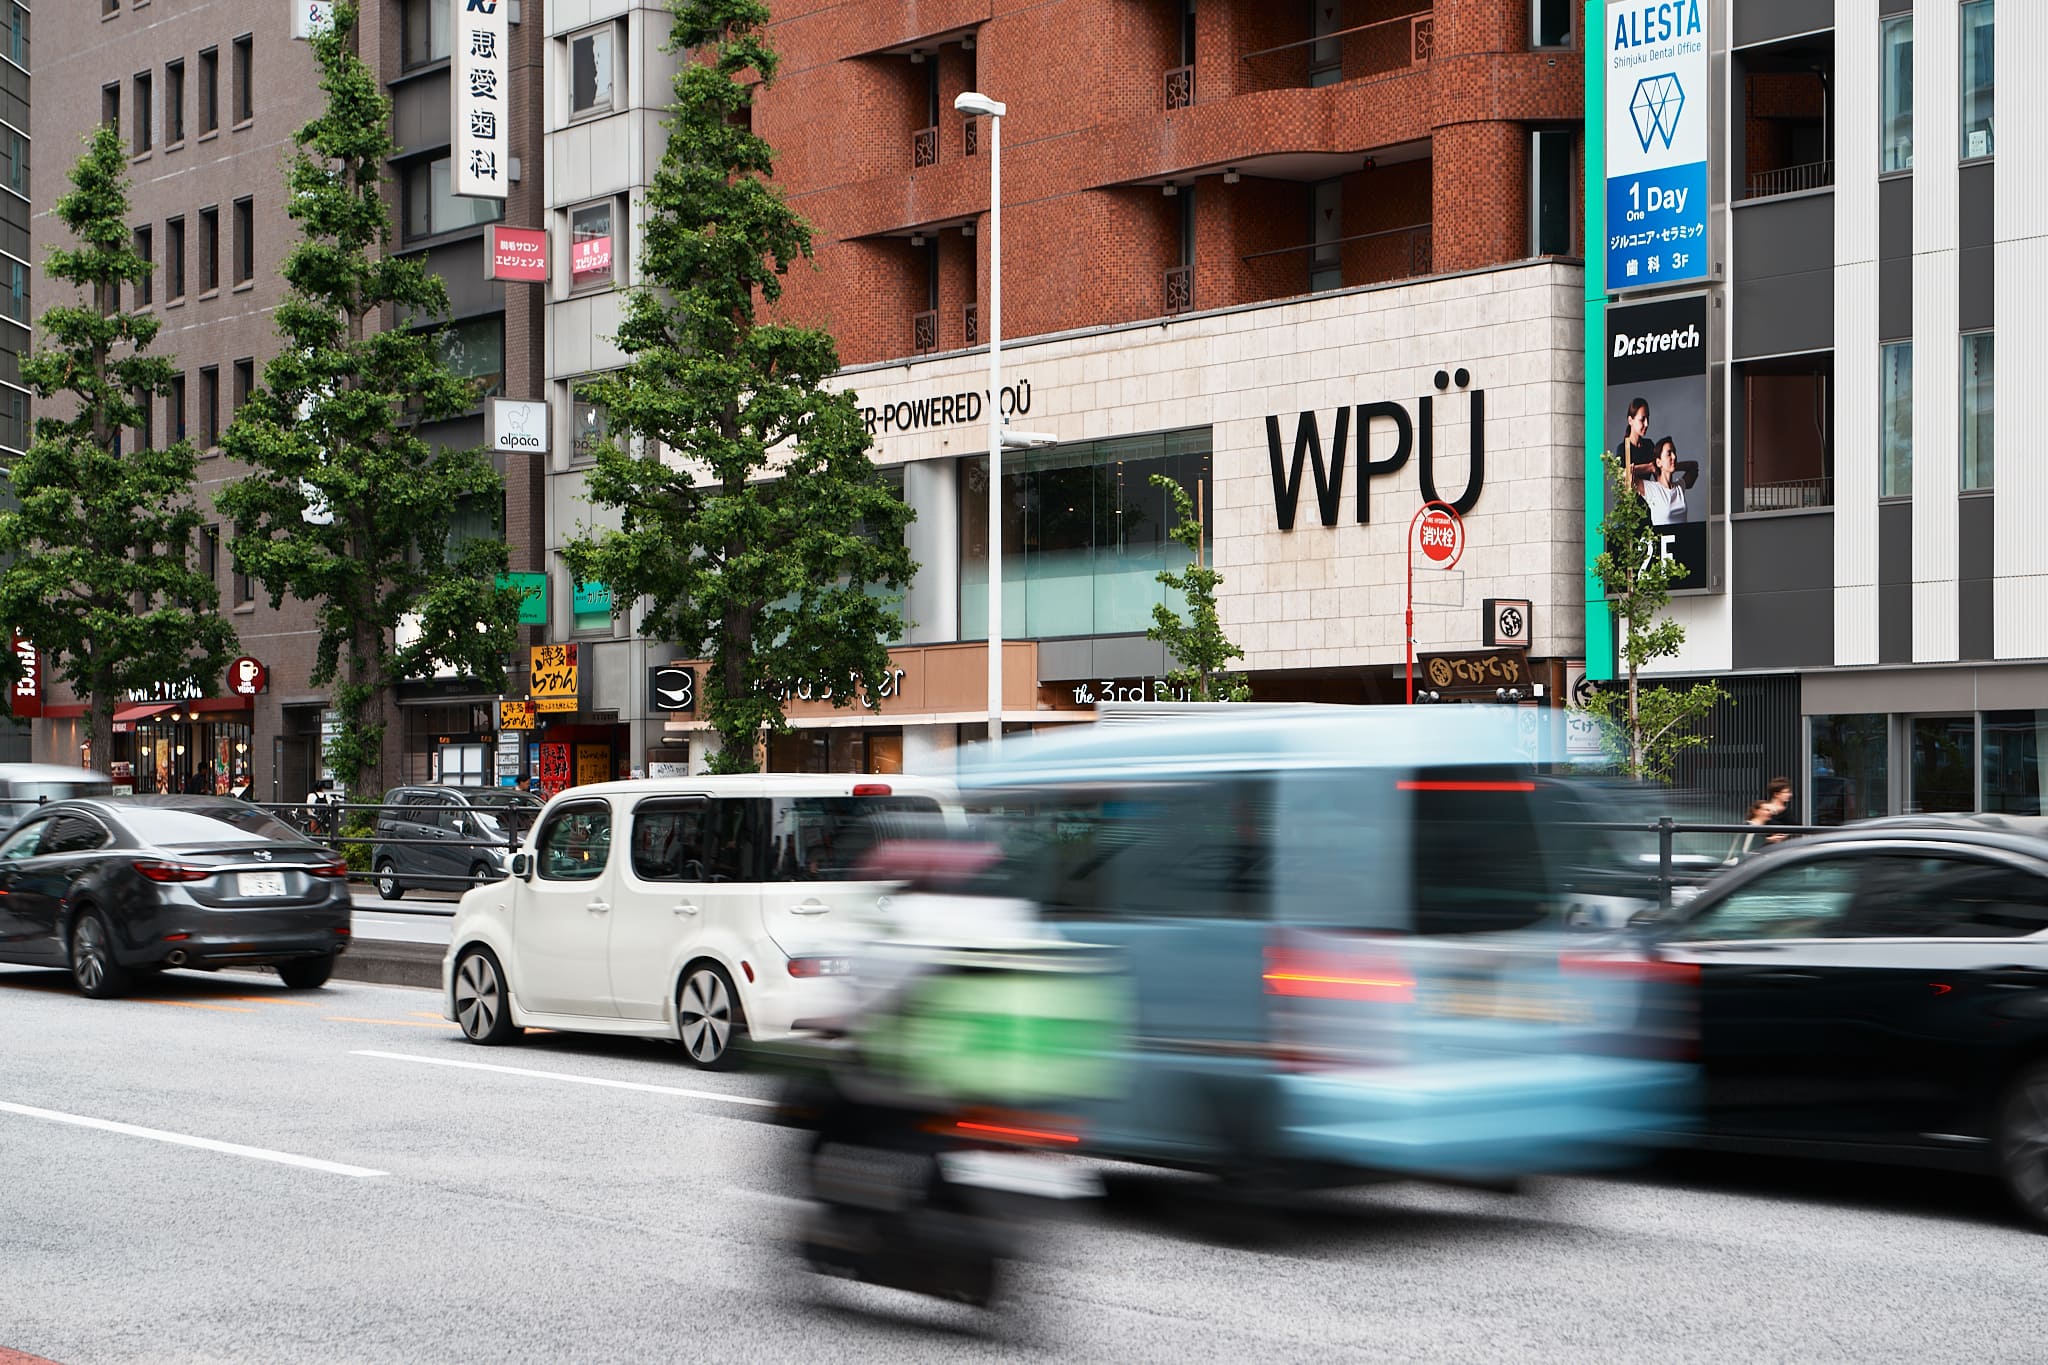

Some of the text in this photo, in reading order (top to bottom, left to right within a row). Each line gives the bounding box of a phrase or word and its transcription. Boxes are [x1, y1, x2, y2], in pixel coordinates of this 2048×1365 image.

[1614, 0, 1701, 51] ALESTA
[1613, 41, 1701, 69] Shinjuku Dental Office
[1629, 181, 1689, 214] 1 Day
[1626, 210, 1645, 222] One
[1610, 222, 1704, 250] ジルコニア・セラミック
[1626, 252, 1689, 277] 歯科 3F
[1613, 323, 1700, 358] Dr.stretch
[500, 432, 539, 449] alpaca
[1265, 367, 1485, 530] WPÜ
[1422, 525, 1454, 548] 消火栓
[540, 645, 566, 667] 博多
[1449, 656, 1519, 684] てけてけ
[1072, 684, 1095, 704] the
[1100, 680, 1145, 703] 3rd
